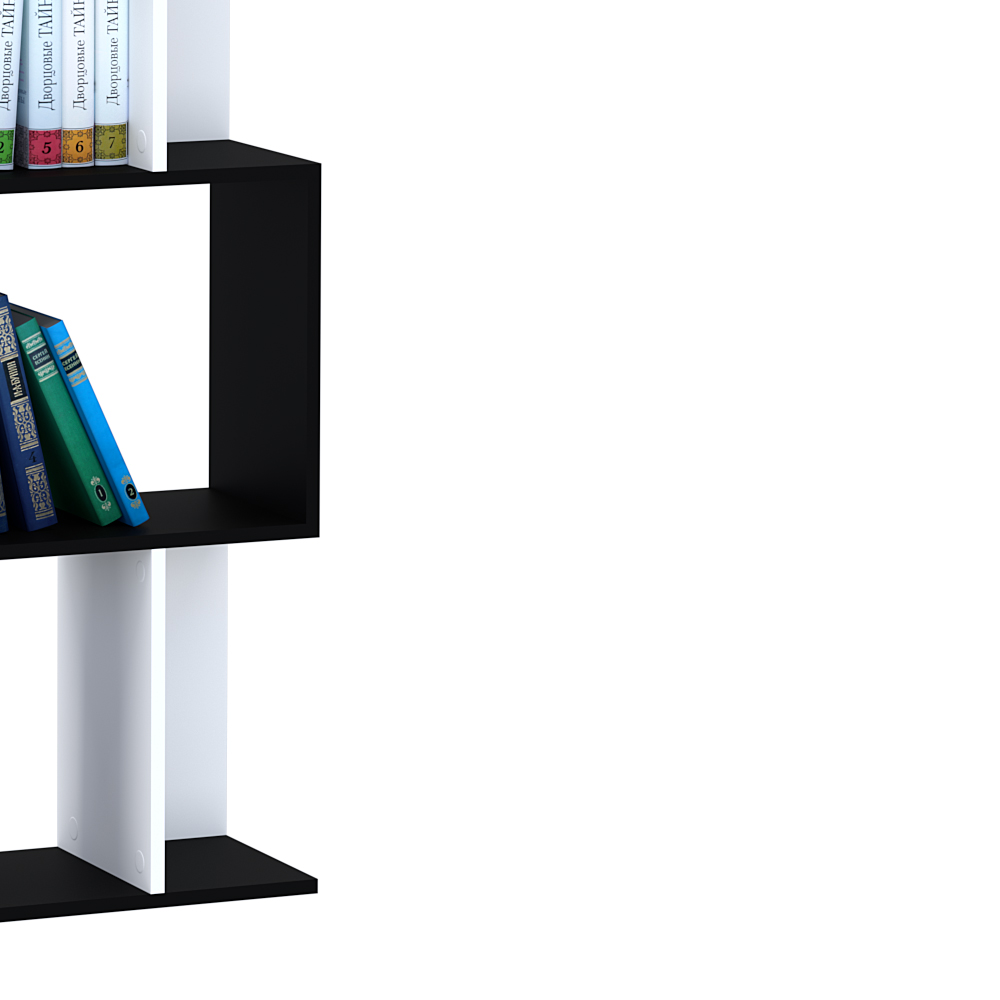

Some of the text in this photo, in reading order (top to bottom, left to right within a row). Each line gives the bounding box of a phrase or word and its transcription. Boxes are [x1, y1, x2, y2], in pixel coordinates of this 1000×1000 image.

[38, 40, 58, 111] Дворцовые
[72, 39, 88, 111] Дворцовые
[106, 37, 122, 106] Дворцовые
[41, 141, 52, 154] 5
[75, 140, 84, 153] 6
[108, 136, 116, 149] 7
[98, 488, 104, 498] 1
[127, 487, 135, 497] 2
